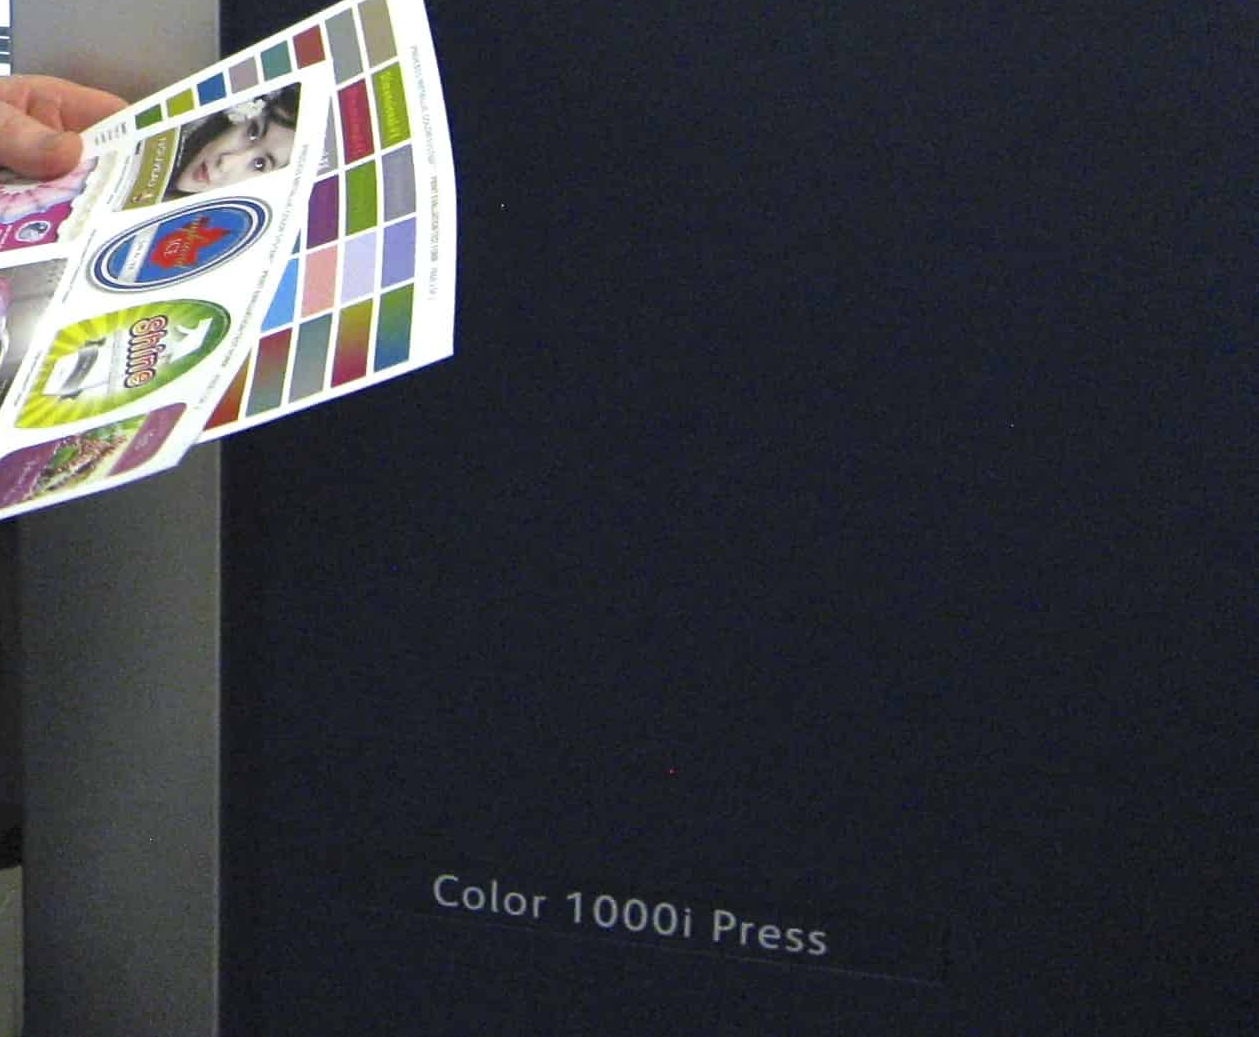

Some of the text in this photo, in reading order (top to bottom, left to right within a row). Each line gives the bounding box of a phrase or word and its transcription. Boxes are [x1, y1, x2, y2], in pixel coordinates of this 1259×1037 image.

[124, 315, 169, 389] Shine
[432, 874, 829, 957] Color 1000i Press
